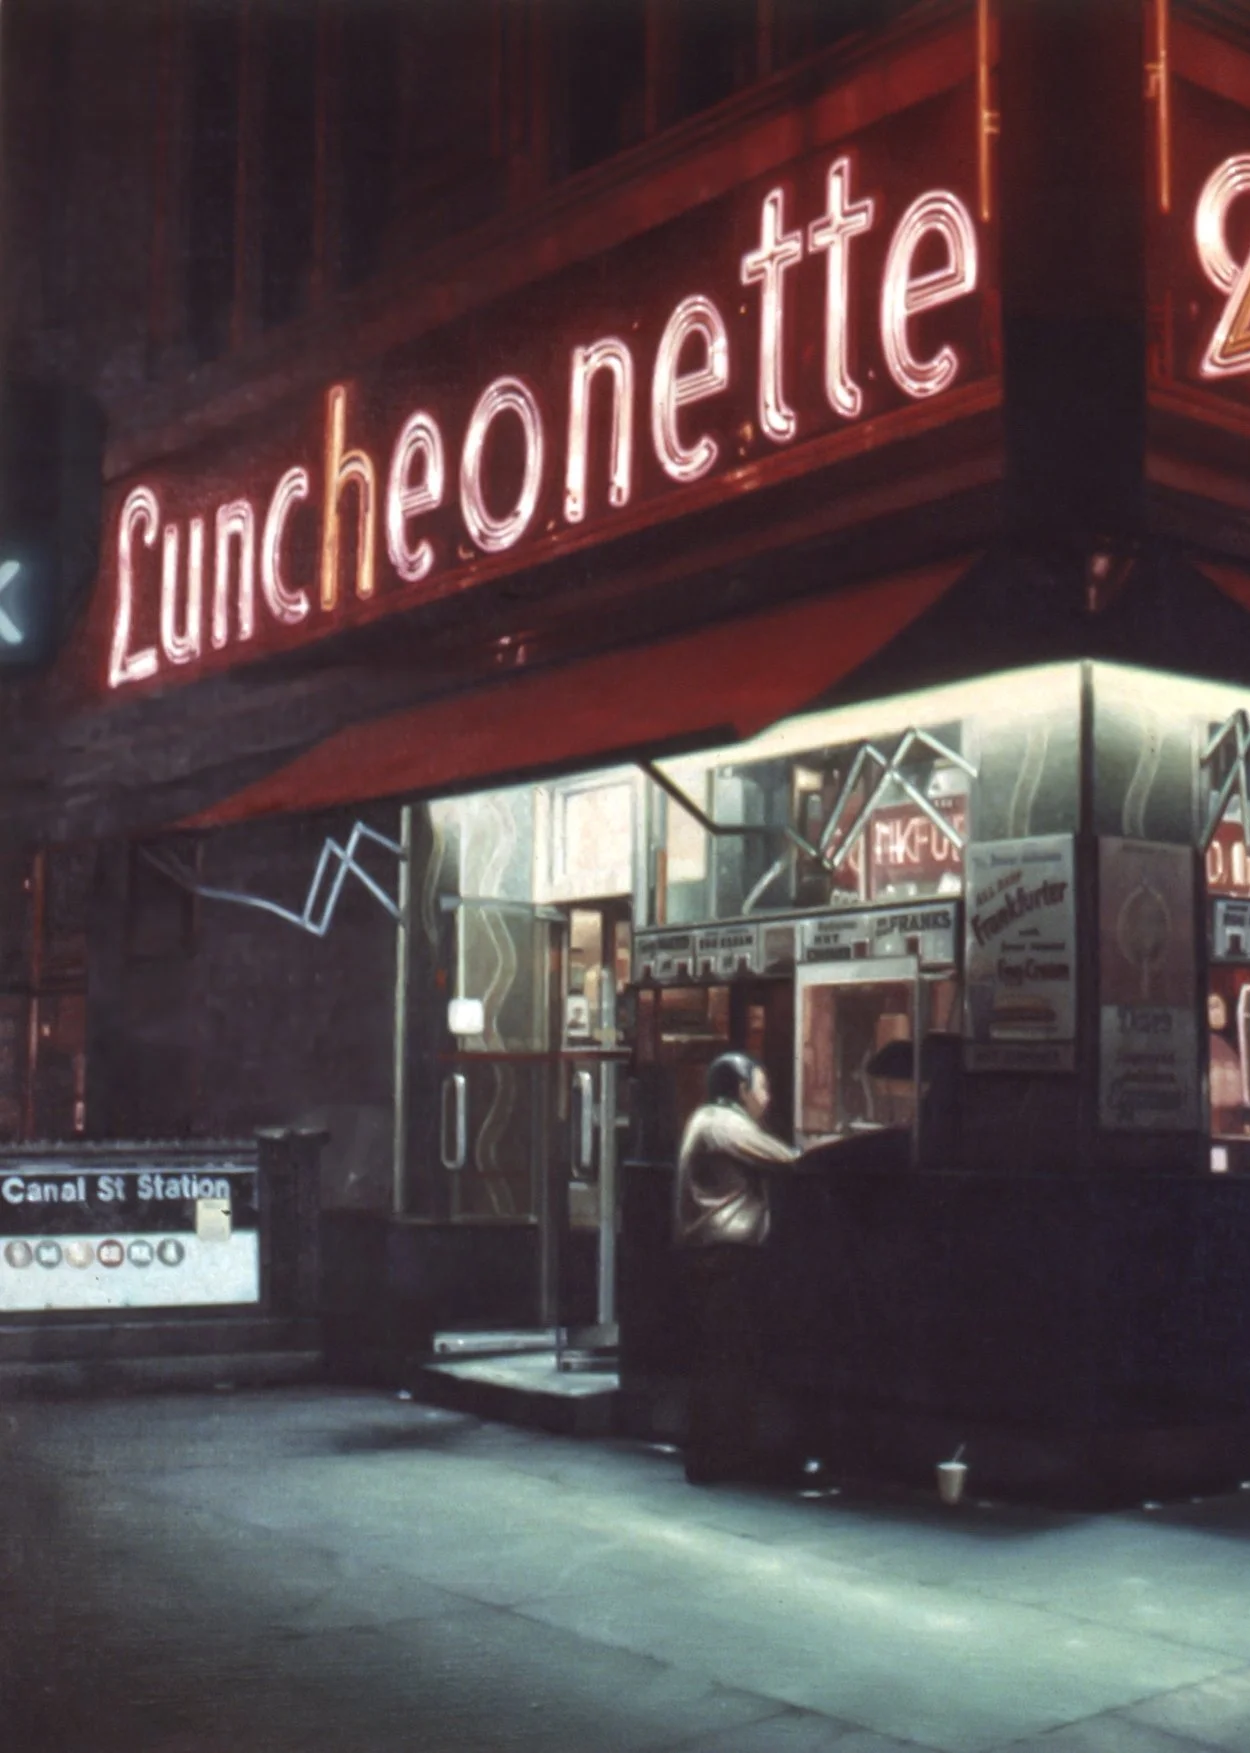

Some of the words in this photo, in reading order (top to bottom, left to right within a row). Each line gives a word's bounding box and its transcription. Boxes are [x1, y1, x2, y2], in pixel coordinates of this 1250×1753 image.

[105, 153, 980, 690] Luncheonette
[2, 1175, 87, 1204] Canal
[97, 1176, 126, 1202] St
[136, 1173, 231, 1200] Station
